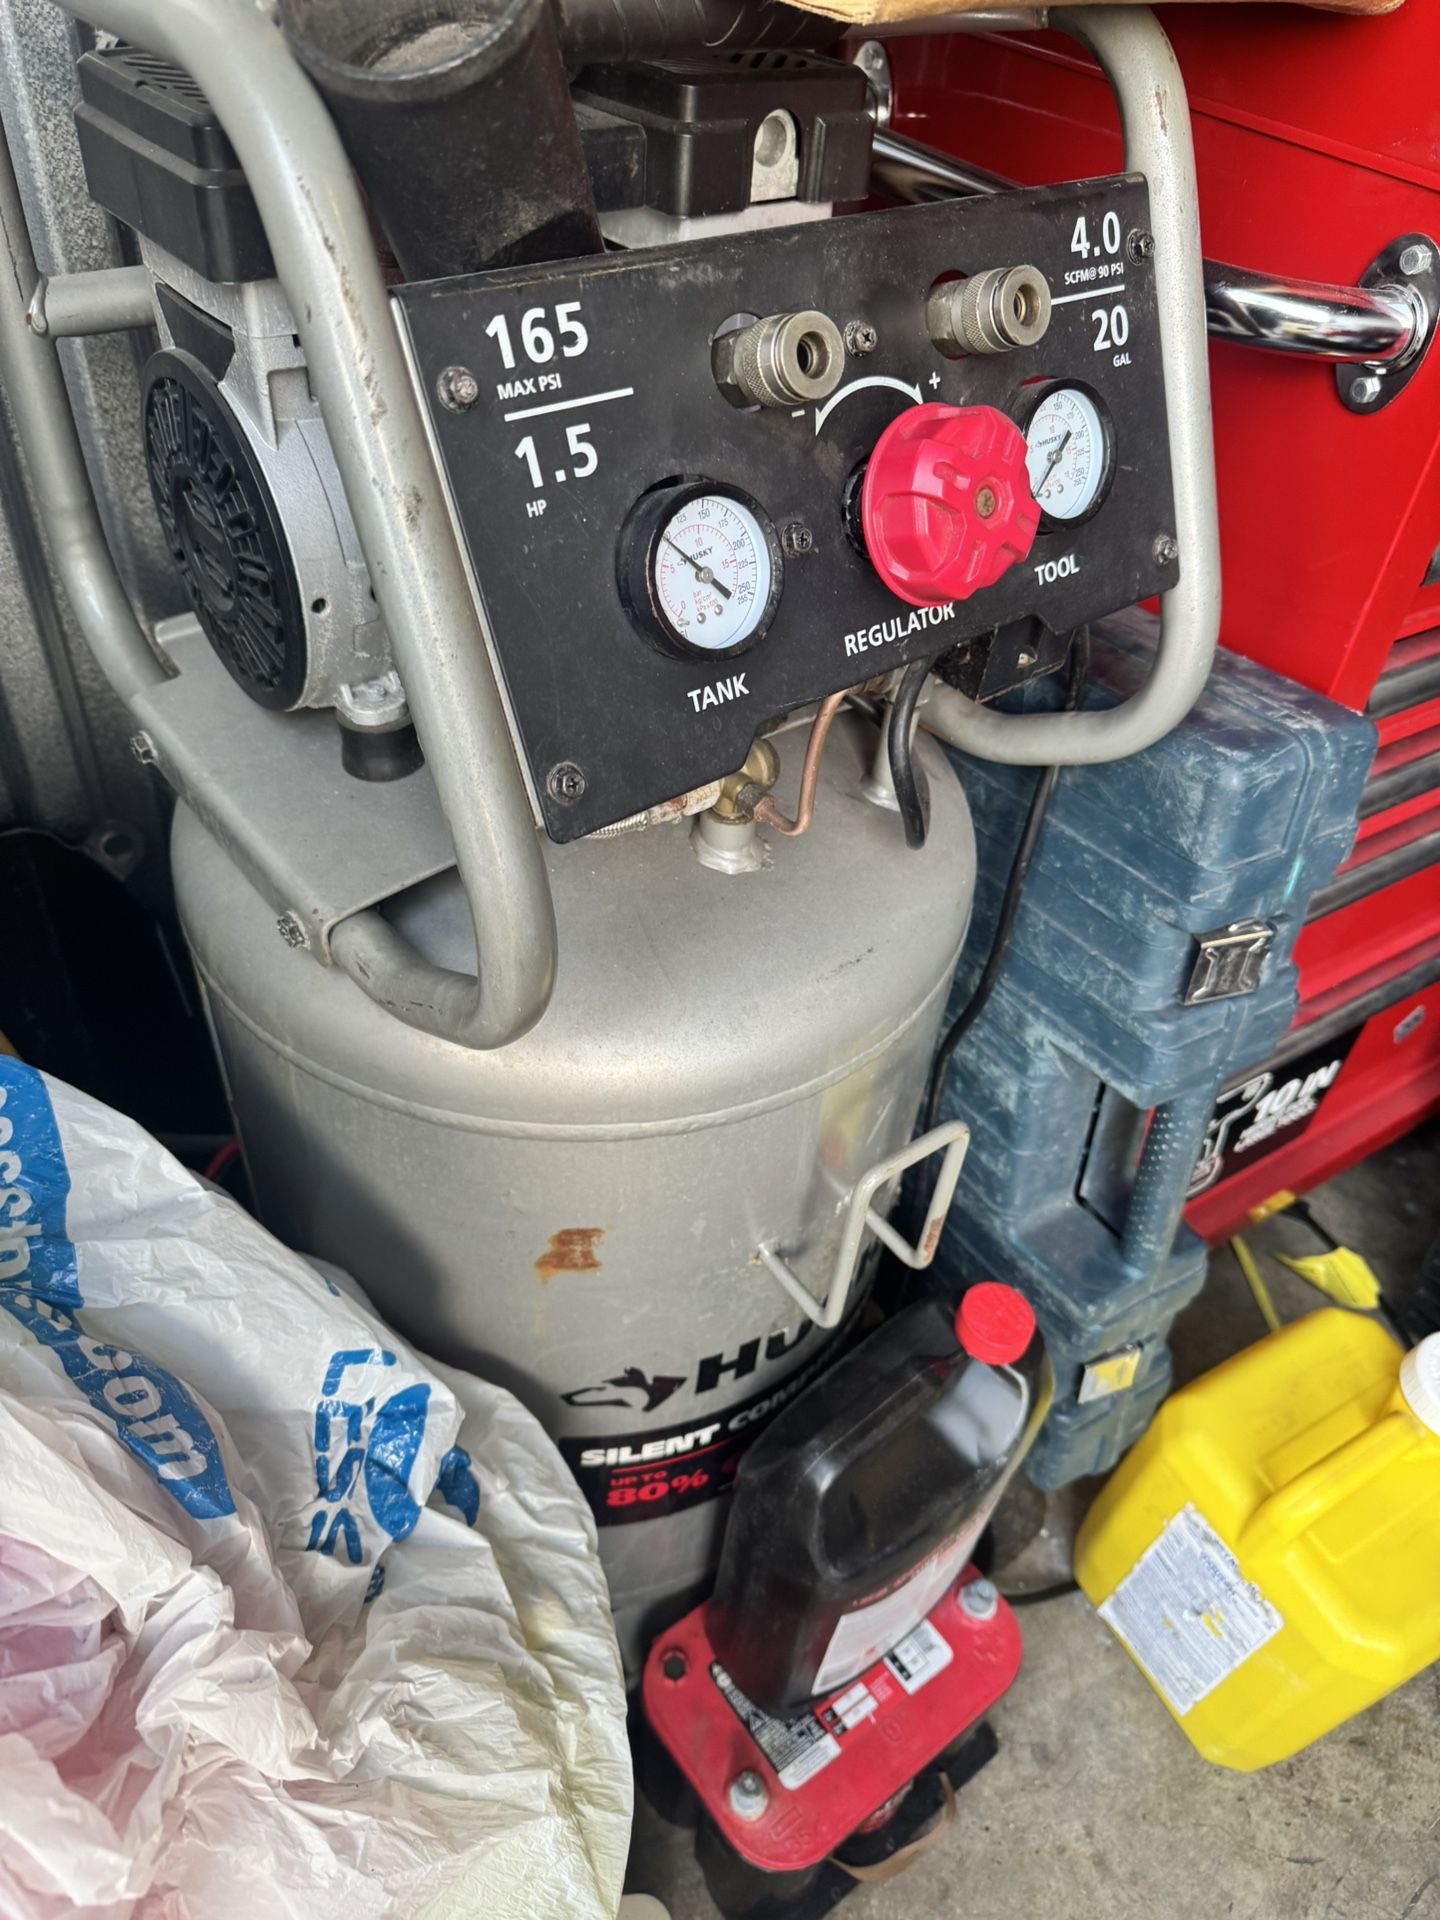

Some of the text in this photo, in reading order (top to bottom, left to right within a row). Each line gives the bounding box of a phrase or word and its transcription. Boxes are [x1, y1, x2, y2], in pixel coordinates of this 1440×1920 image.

[1070, 211, 1121, 259] 4.0
[1097, 265, 1110, 279] 90
[1110, 262, 1124, 277] PSI
[485, 301, 589, 369] 165
[1091, 304, 1129, 352] 20
[1112, 352, 1132, 367] GAL
[496, 373, 563, 400] MAX PSI
[514, 423, 598, 488] 1.5
[526, 499, 547, 518] HP
[697, 507, 711, 520] 150
[718, 518, 729, 529] 175
[732, 539, 746, 550] 200
[721, 559, 730, 570] 15
[738, 558, 749, 569] 225
[1034, 553, 1081, 586] TOOL
[737, 581, 751, 594] 250
[843, 602, 956, 657] REGULATOR
[687, 672, 750, 713] TANK
[580, 1423, 721, 1467] SILENT
[606, 1469, 709, 1507] 80%
